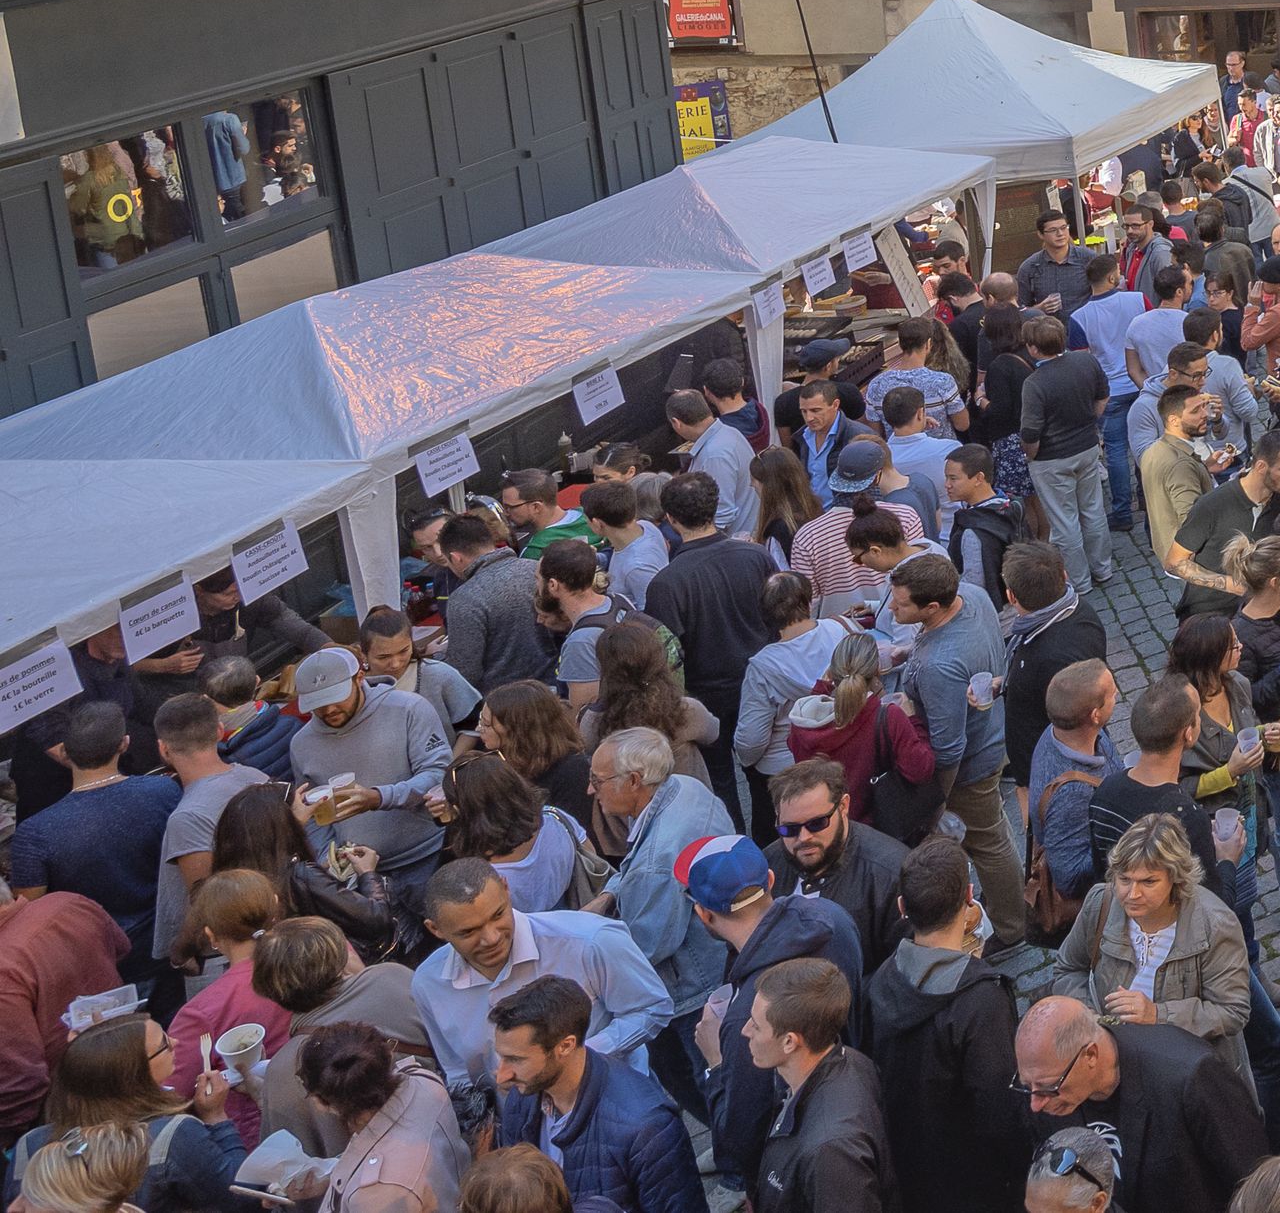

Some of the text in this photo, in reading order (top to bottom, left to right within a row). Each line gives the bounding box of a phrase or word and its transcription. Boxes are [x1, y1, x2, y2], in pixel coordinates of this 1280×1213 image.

[242, 570, 262, 583] Boudin
[151, 607, 160, 617] de
[161, 595, 187, 611] canards
[135, 629, 144, 637] 4€
[151, 610, 185, 630] barquette
[9, 673, 20, 683] de
[21, 655, 56, 678] pommes
[1, 669, 57, 702] 4€ la bouteille
[24, 698, 32, 706] le
[33, 687, 55, 701] verre
[425, 740, 446, 753] adidas
